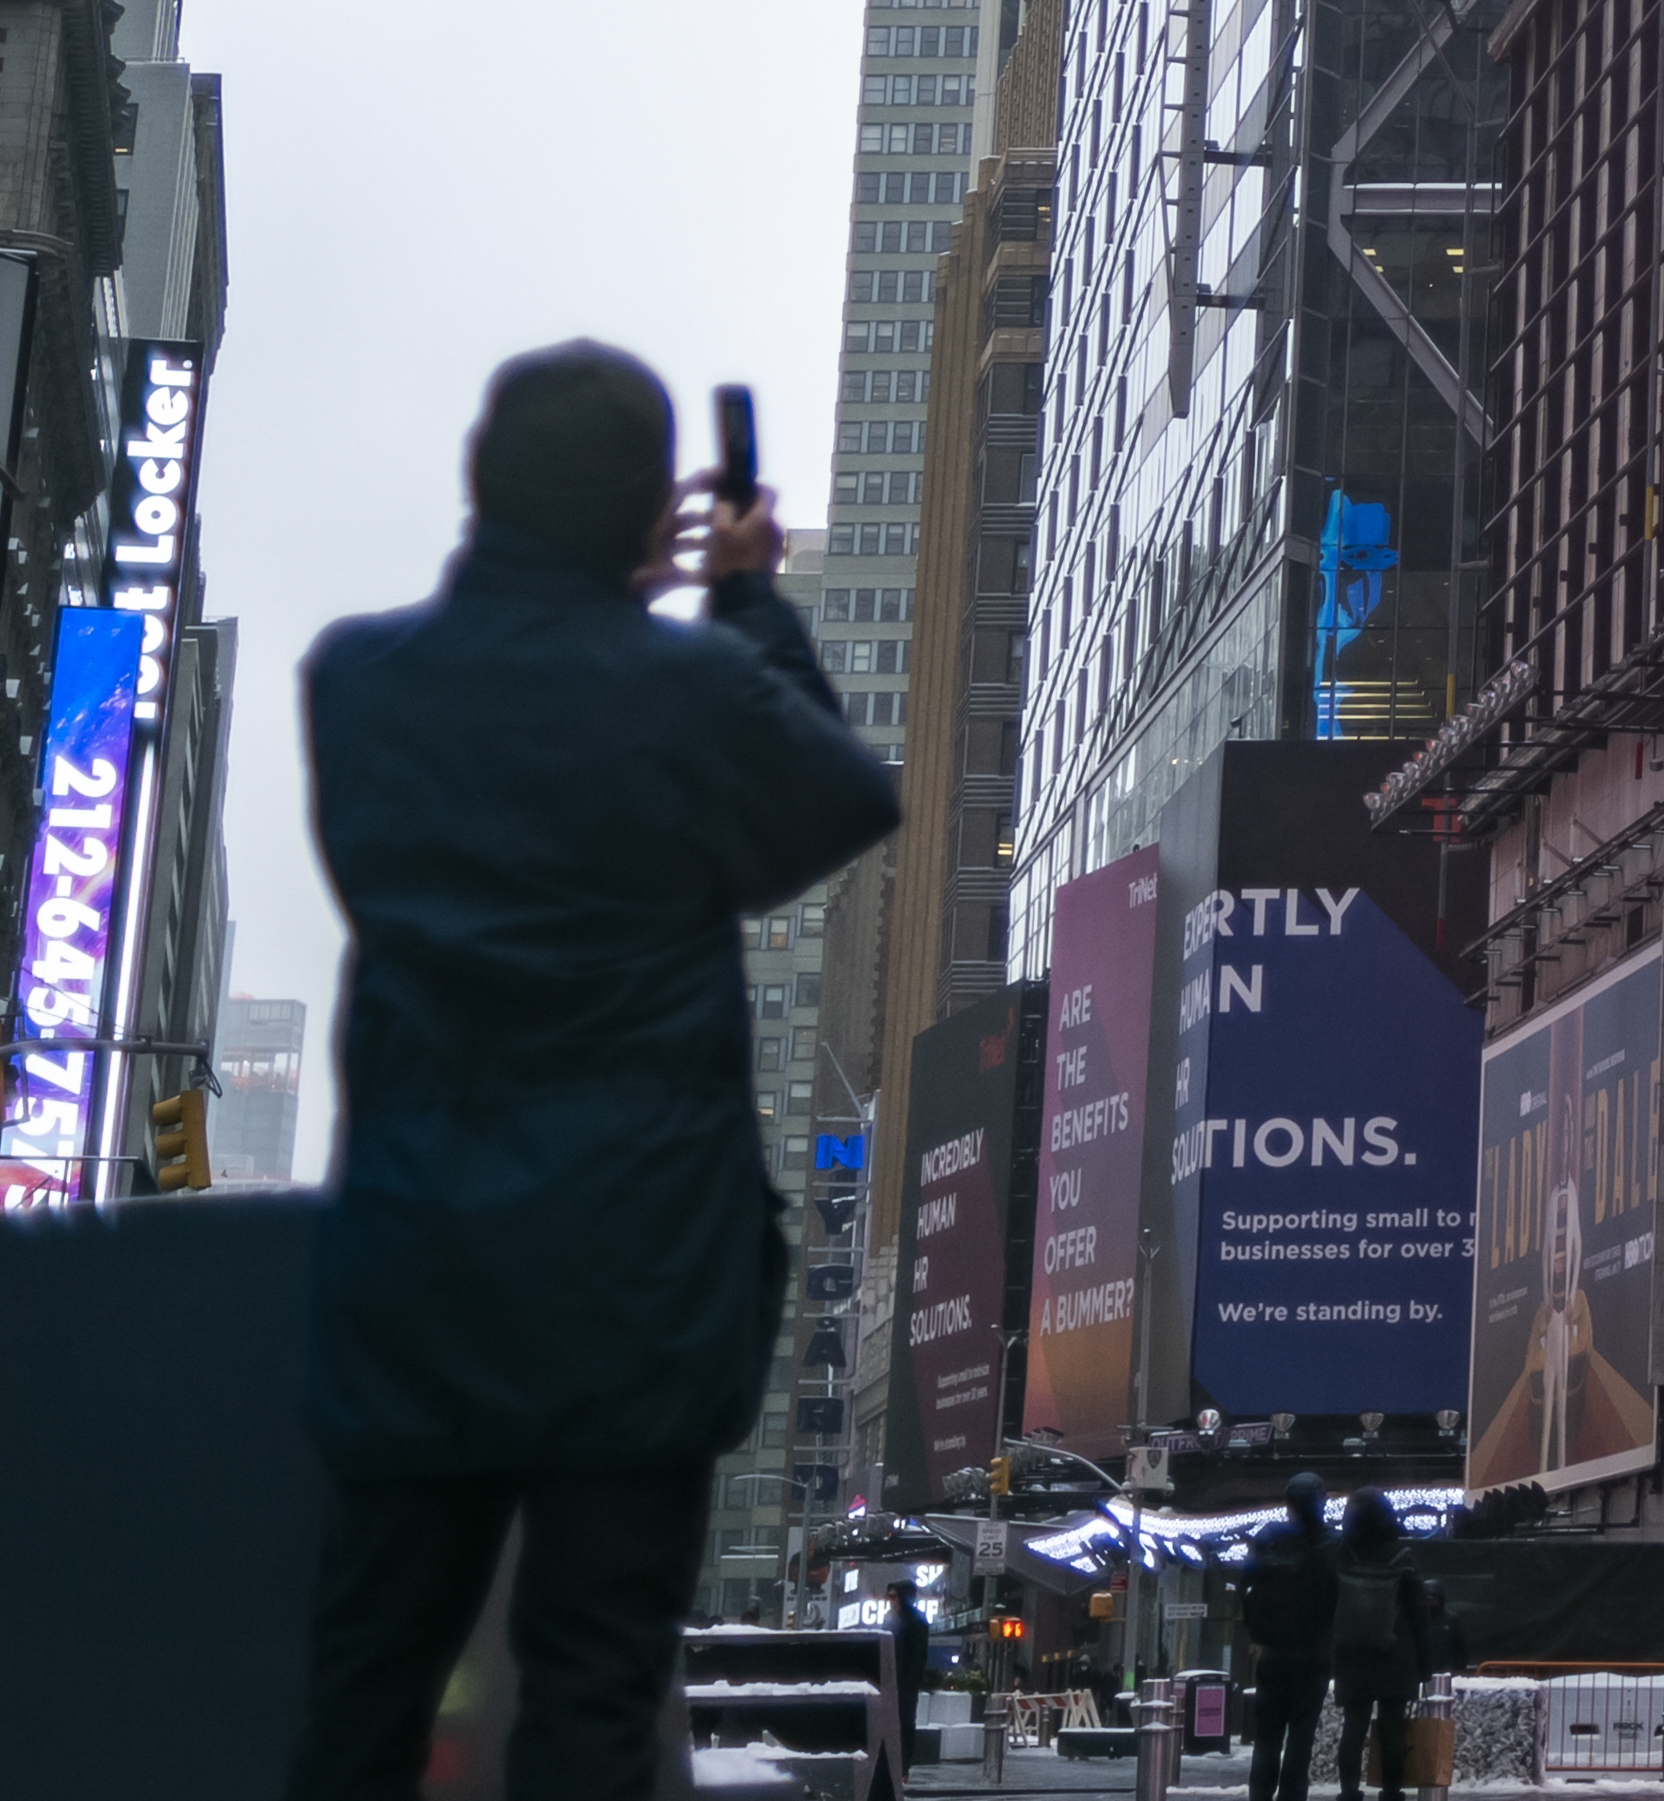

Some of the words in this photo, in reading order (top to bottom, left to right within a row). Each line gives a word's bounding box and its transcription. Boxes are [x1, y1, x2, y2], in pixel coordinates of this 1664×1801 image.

[1059, 984, 1093, 1031] ARE
[1057, 1045, 1087, 1091] THE
[1175, 1057, 1190, 1111] HR
[1051, 1092, 1129, 1152] BENEFITS
[921, 1127, 984, 1188] INCREDIBLY
[1050, 1168, 1082, 1212] YOU
[917, 1192, 957, 1240] HUMAN
[1222, 1209, 1358, 1233] Supporting
[1365, 1208, 1429, 1228] small
[1436, 1210, 1461, 1227] to
[1044, 1225, 1097, 1275] OFFER
[1220, 1241, 1351, 1261] businesses
[1358, 1239, 1393, 1258] for
[1400, 1242, 1454, 1258] over
[913, 1256, 929, 1294] HR
[909, 1294, 973, 1347] SOLUTIONS.
[1040, 1297, 1052, 1337] A
[1055, 1278, 1135, 1334] BUMMER?
[1296, 1301, 1401, 1323] standing
[1409, 1300, 1443, 1323] by.
[979, 1541, 1003, 1557] 25
